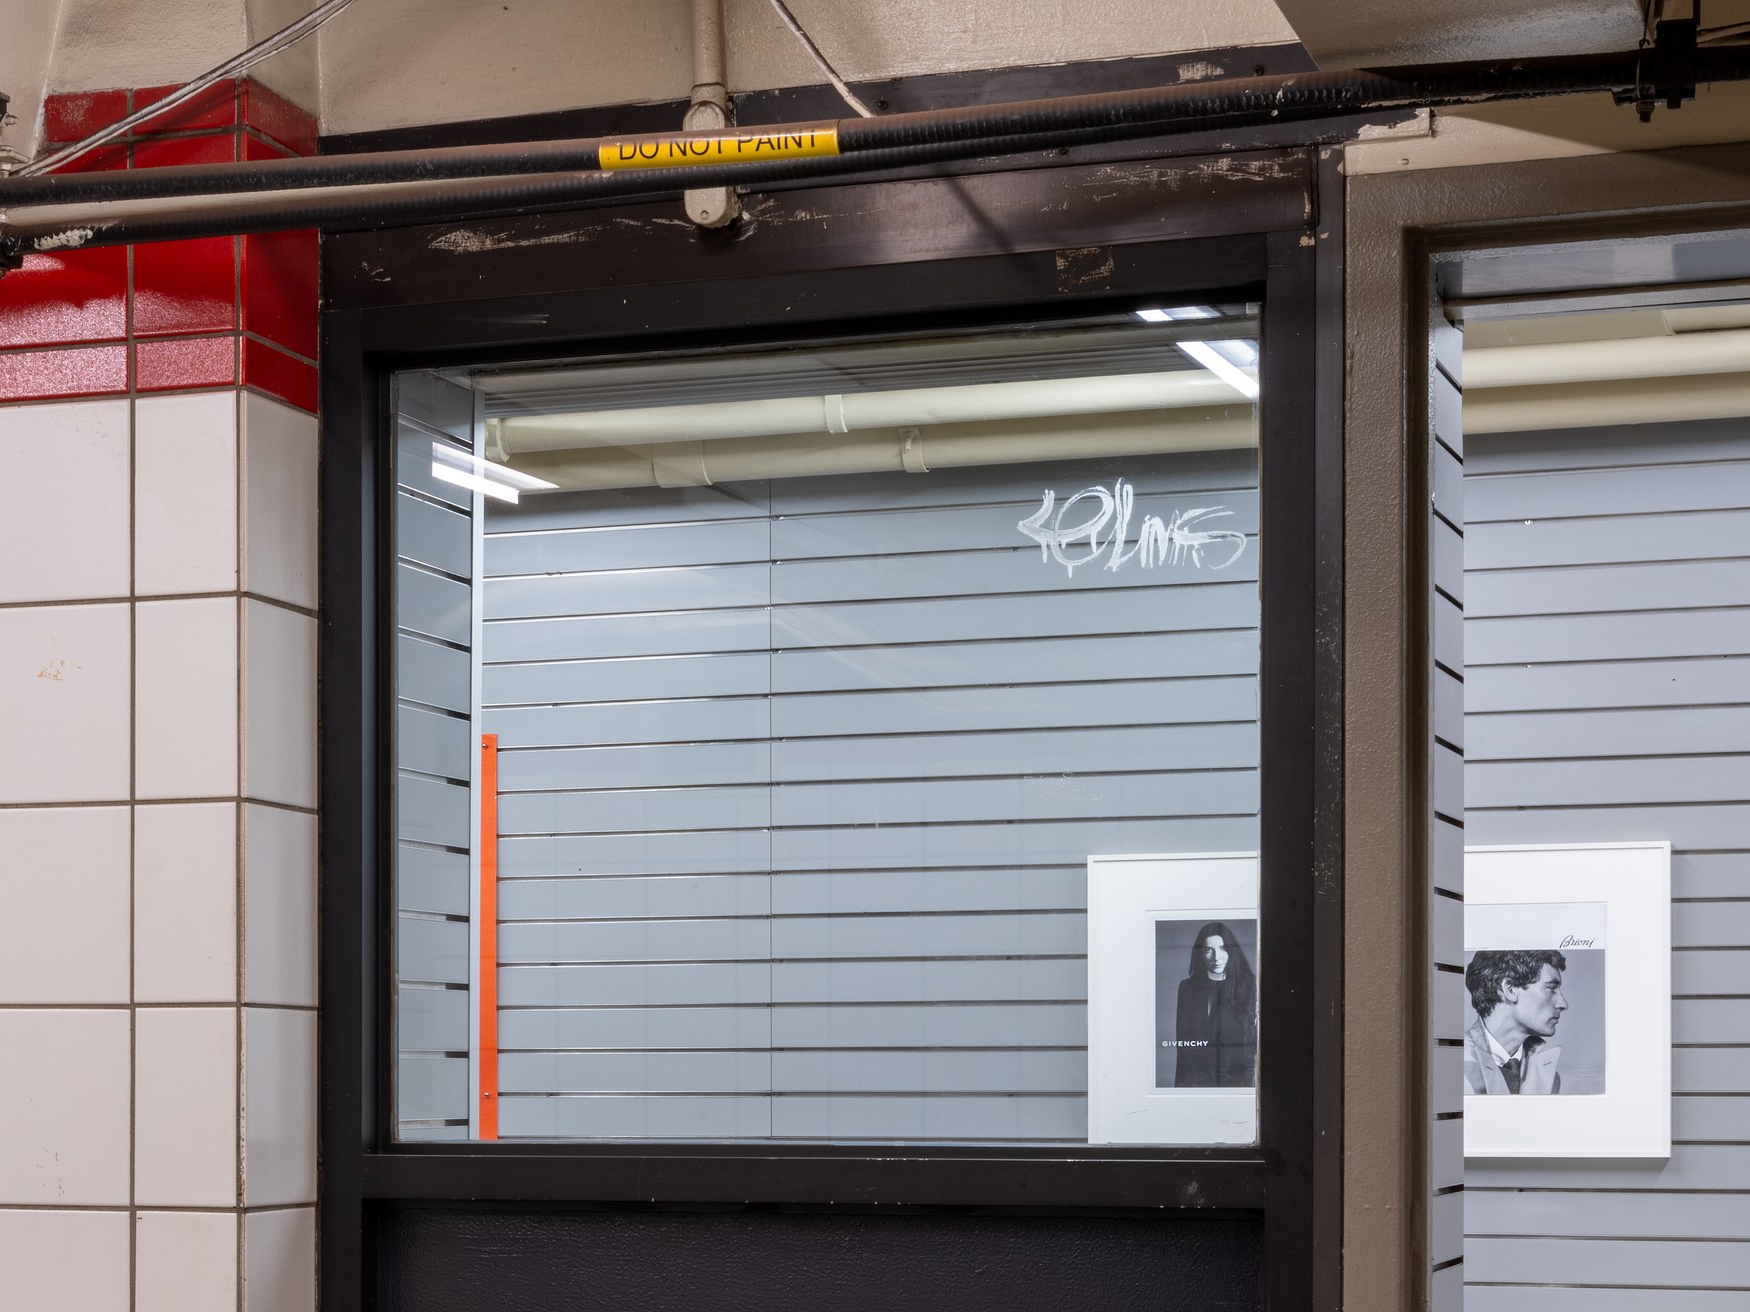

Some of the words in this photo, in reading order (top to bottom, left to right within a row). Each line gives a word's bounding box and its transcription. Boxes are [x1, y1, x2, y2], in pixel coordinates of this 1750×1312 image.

[619, 140, 660, 160] DO
[669, 136, 723, 157] NOT
[737, 128, 817, 153] PAINT
